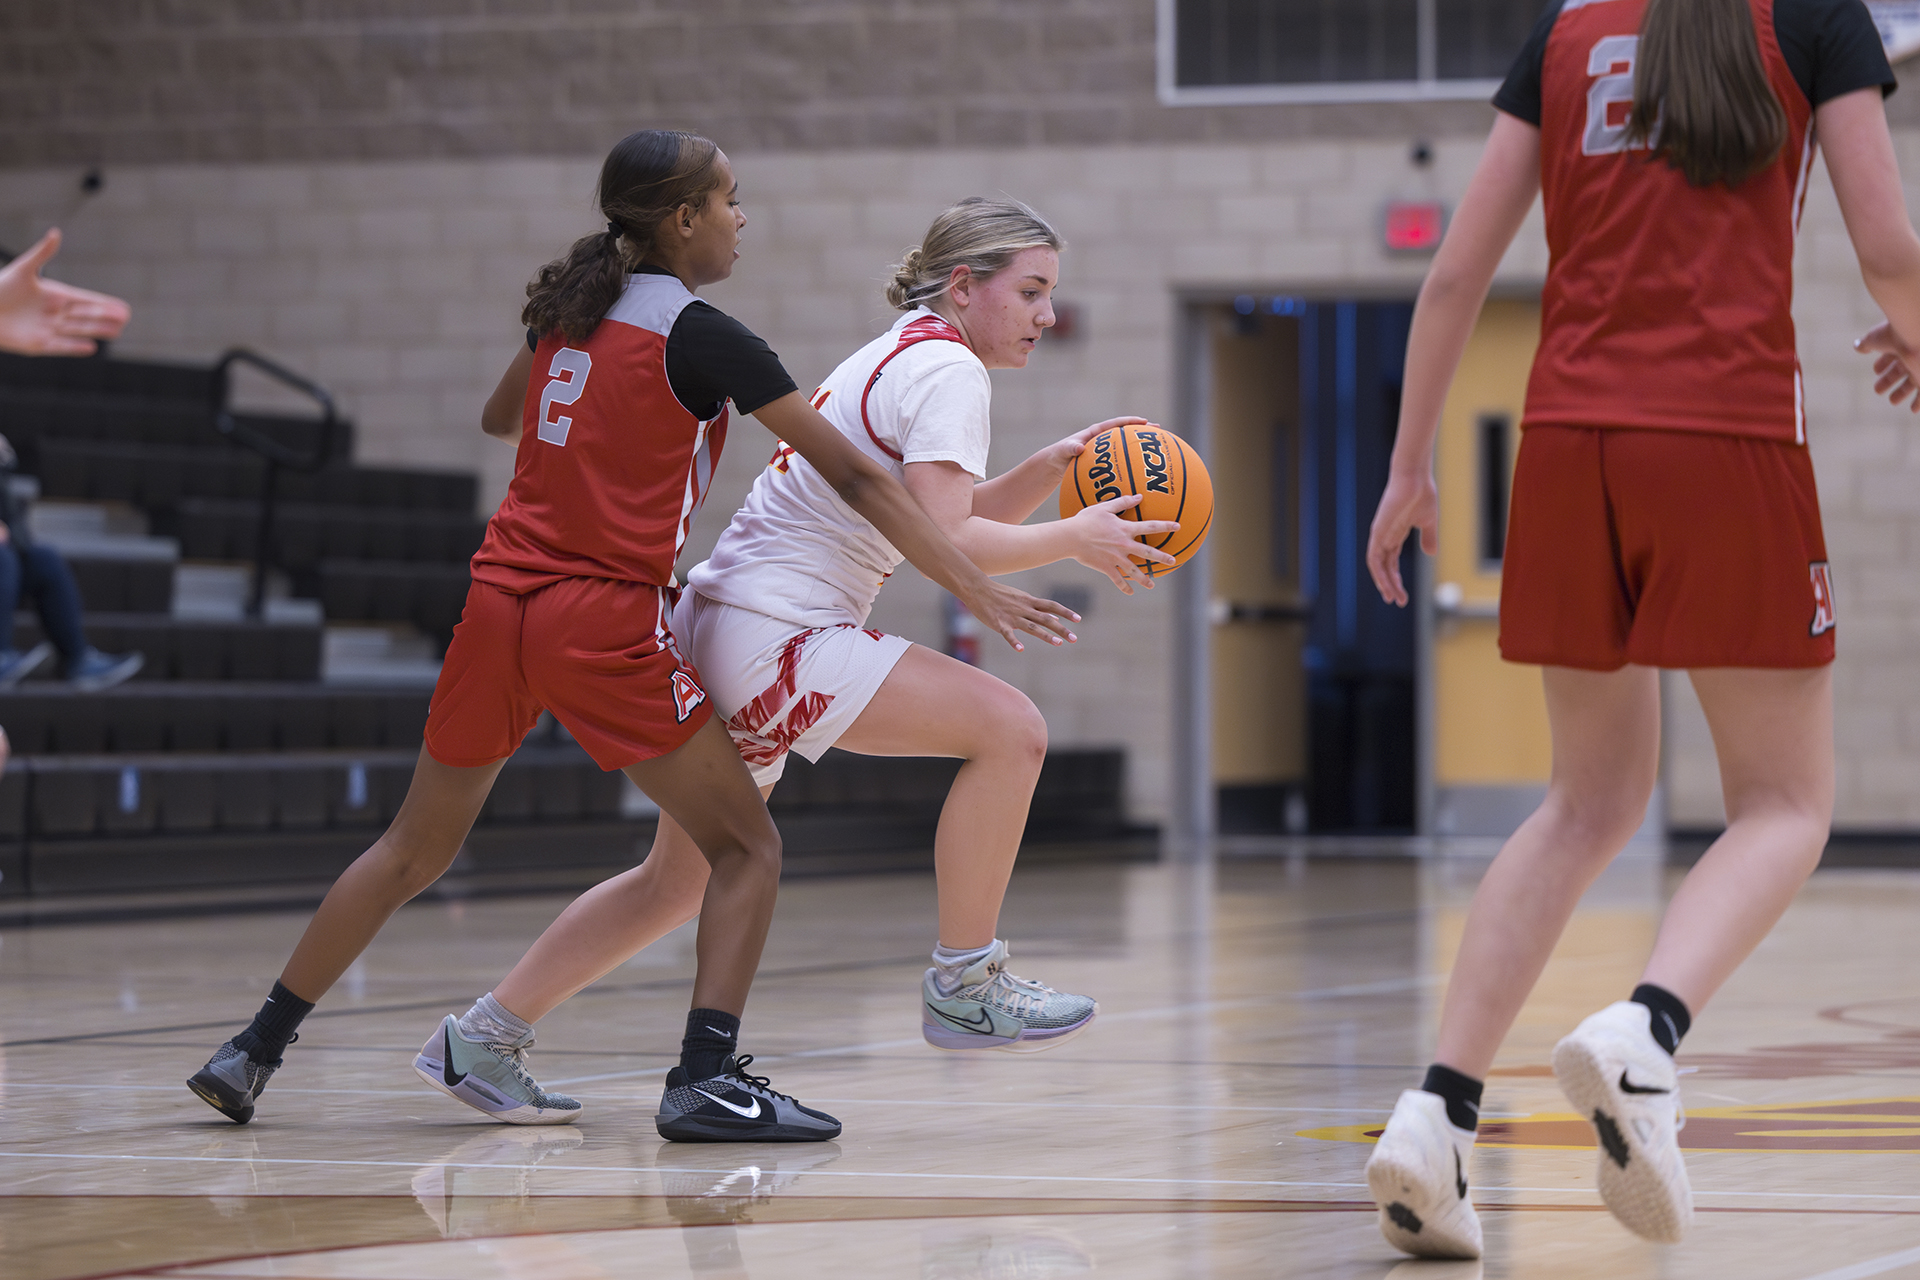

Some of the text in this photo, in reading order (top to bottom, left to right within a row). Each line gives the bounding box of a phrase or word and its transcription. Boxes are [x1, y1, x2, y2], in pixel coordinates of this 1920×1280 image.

[1582, 34, 1664, 156] 2
[538, 347, 592, 447] 2
[1135, 431, 1170, 495] NCAA
[668, 668, 707, 725] A
